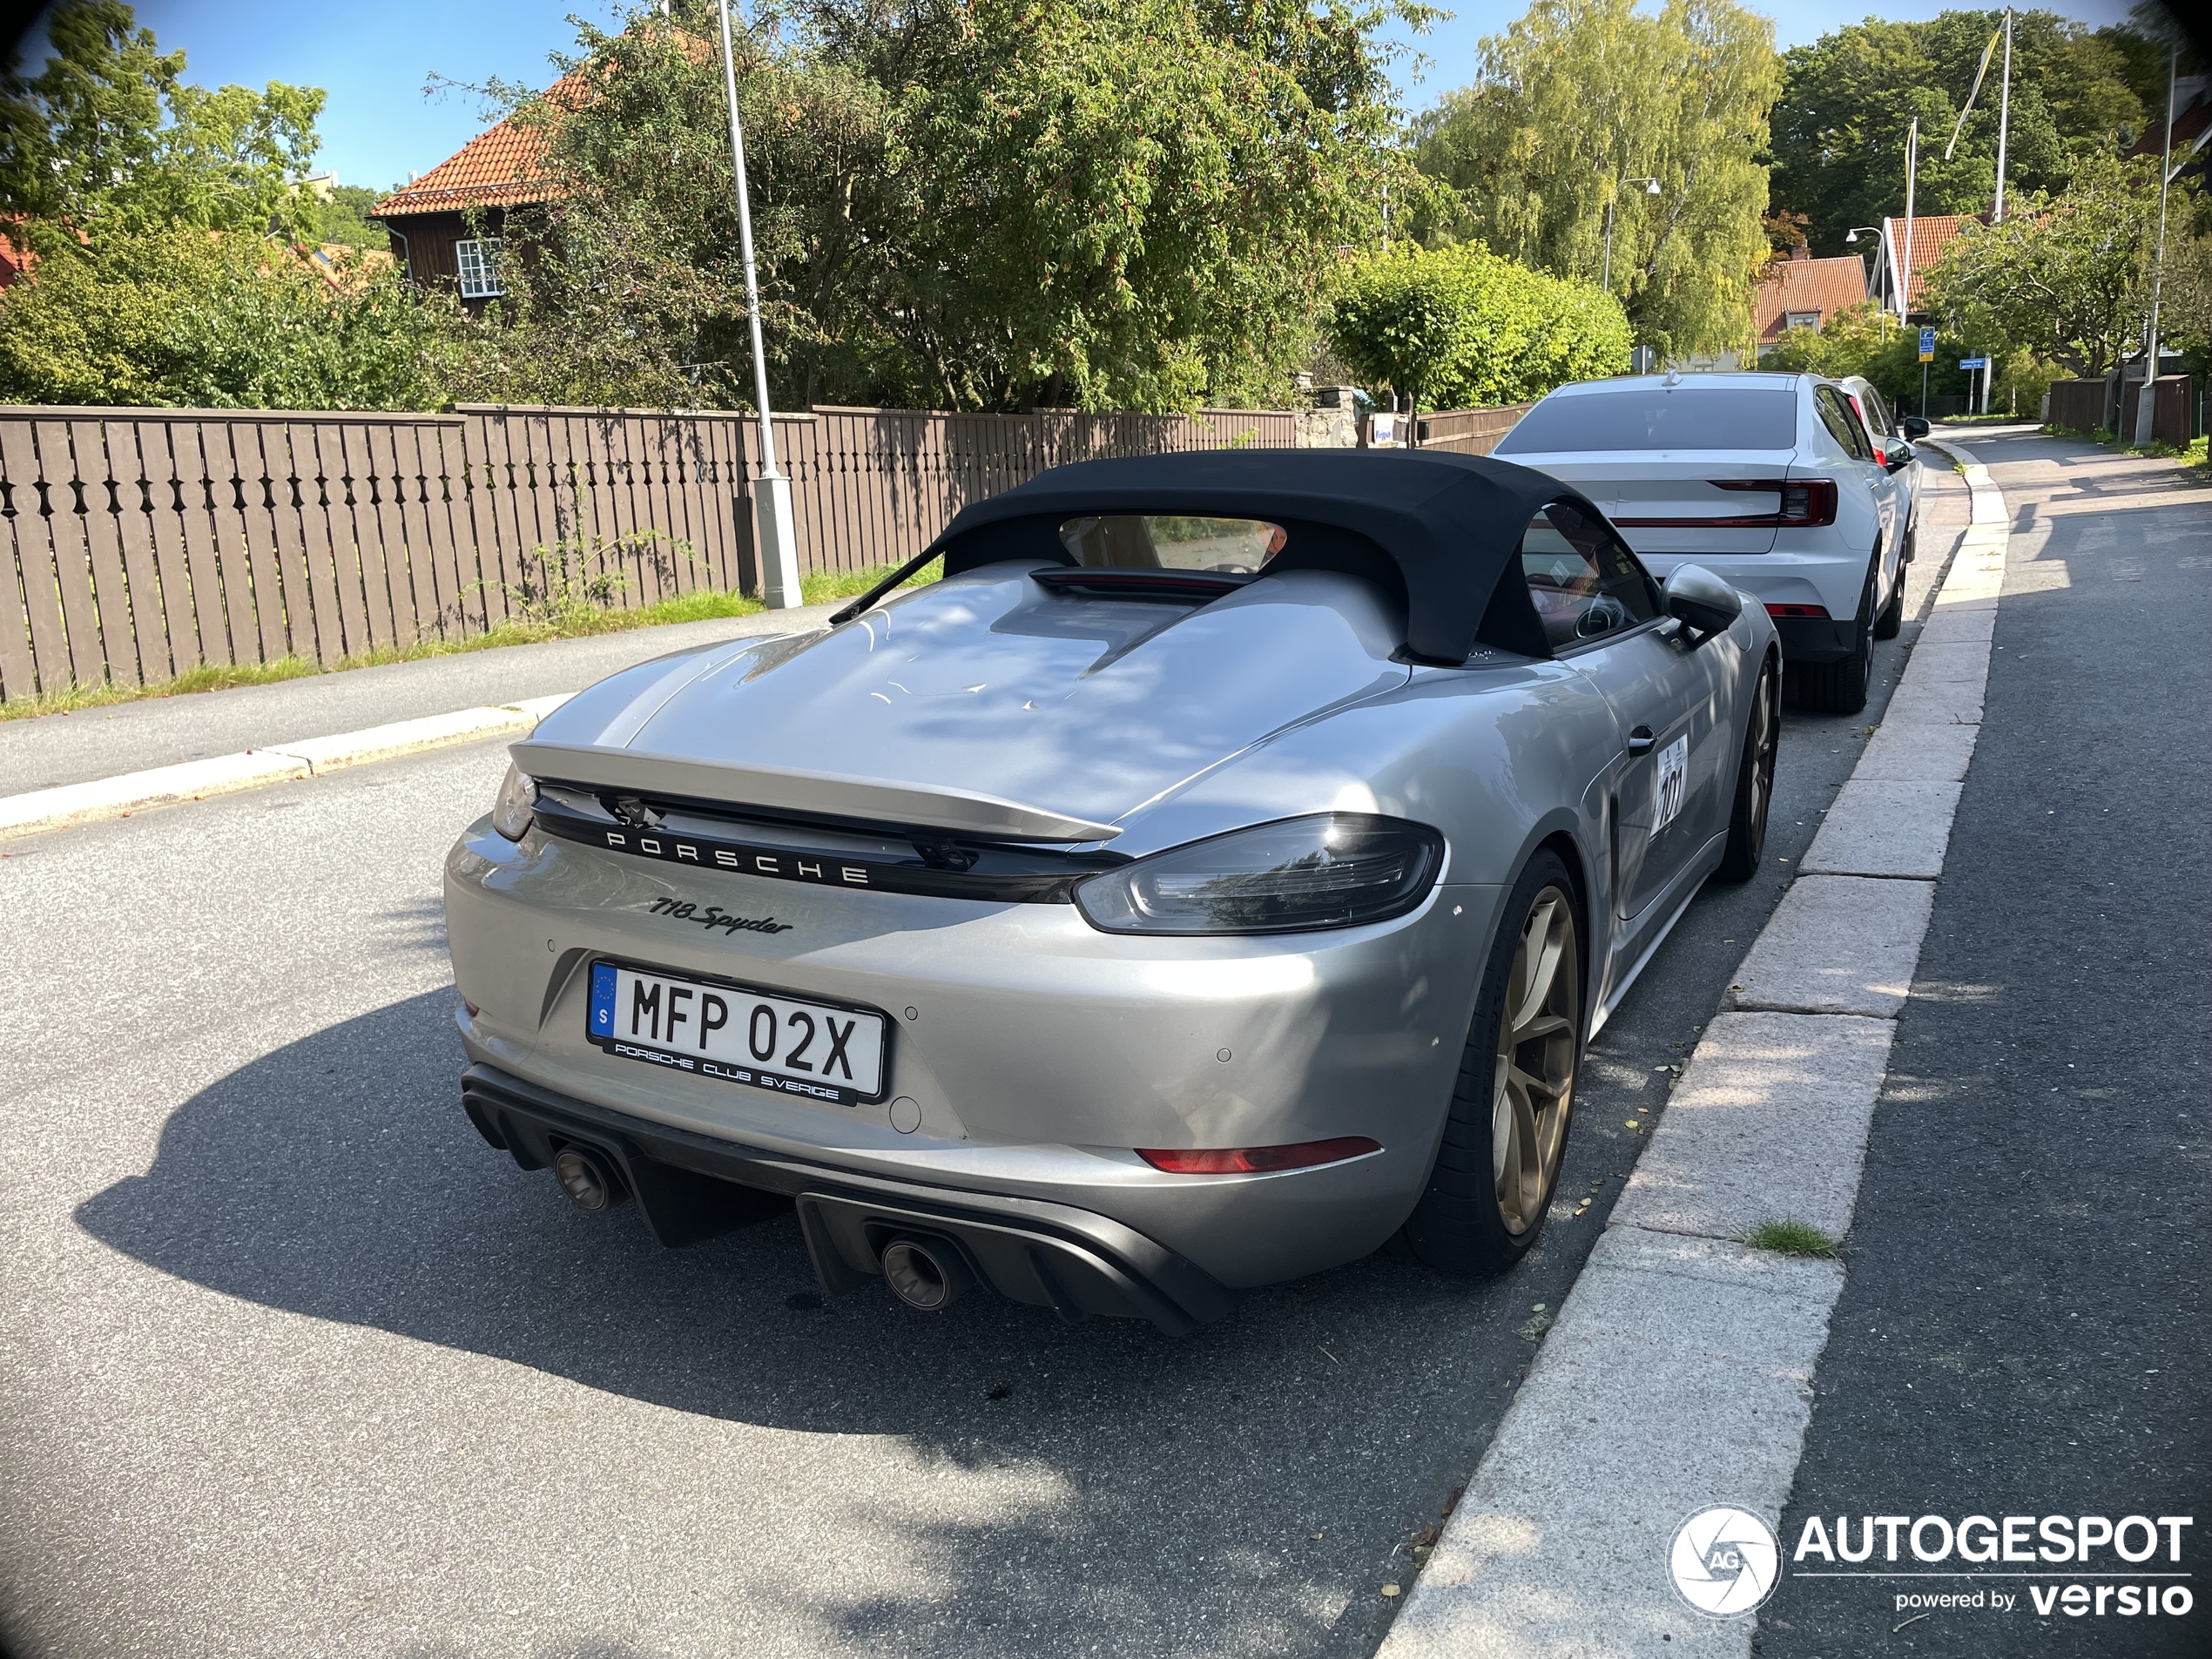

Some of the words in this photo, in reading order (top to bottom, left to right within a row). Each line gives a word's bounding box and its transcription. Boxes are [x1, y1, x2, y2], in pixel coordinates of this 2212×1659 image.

[1660, 765, 1683, 826] 101
[606, 832, 869, 884] PORSCHE
[649, 897, 697, 919] 718
[689, 907, 793, 936] Spyder
[598, 1008, 608, 1024] S
[631, 979, 728, 1050] MFP
[749, 1004, 856, 1080] 02X
[615, 1043, 694, 1069] PORSCHE
[702, 1064, 752, 1082] CLUB
[760, 1076, 840, 1100] SVERIGE
